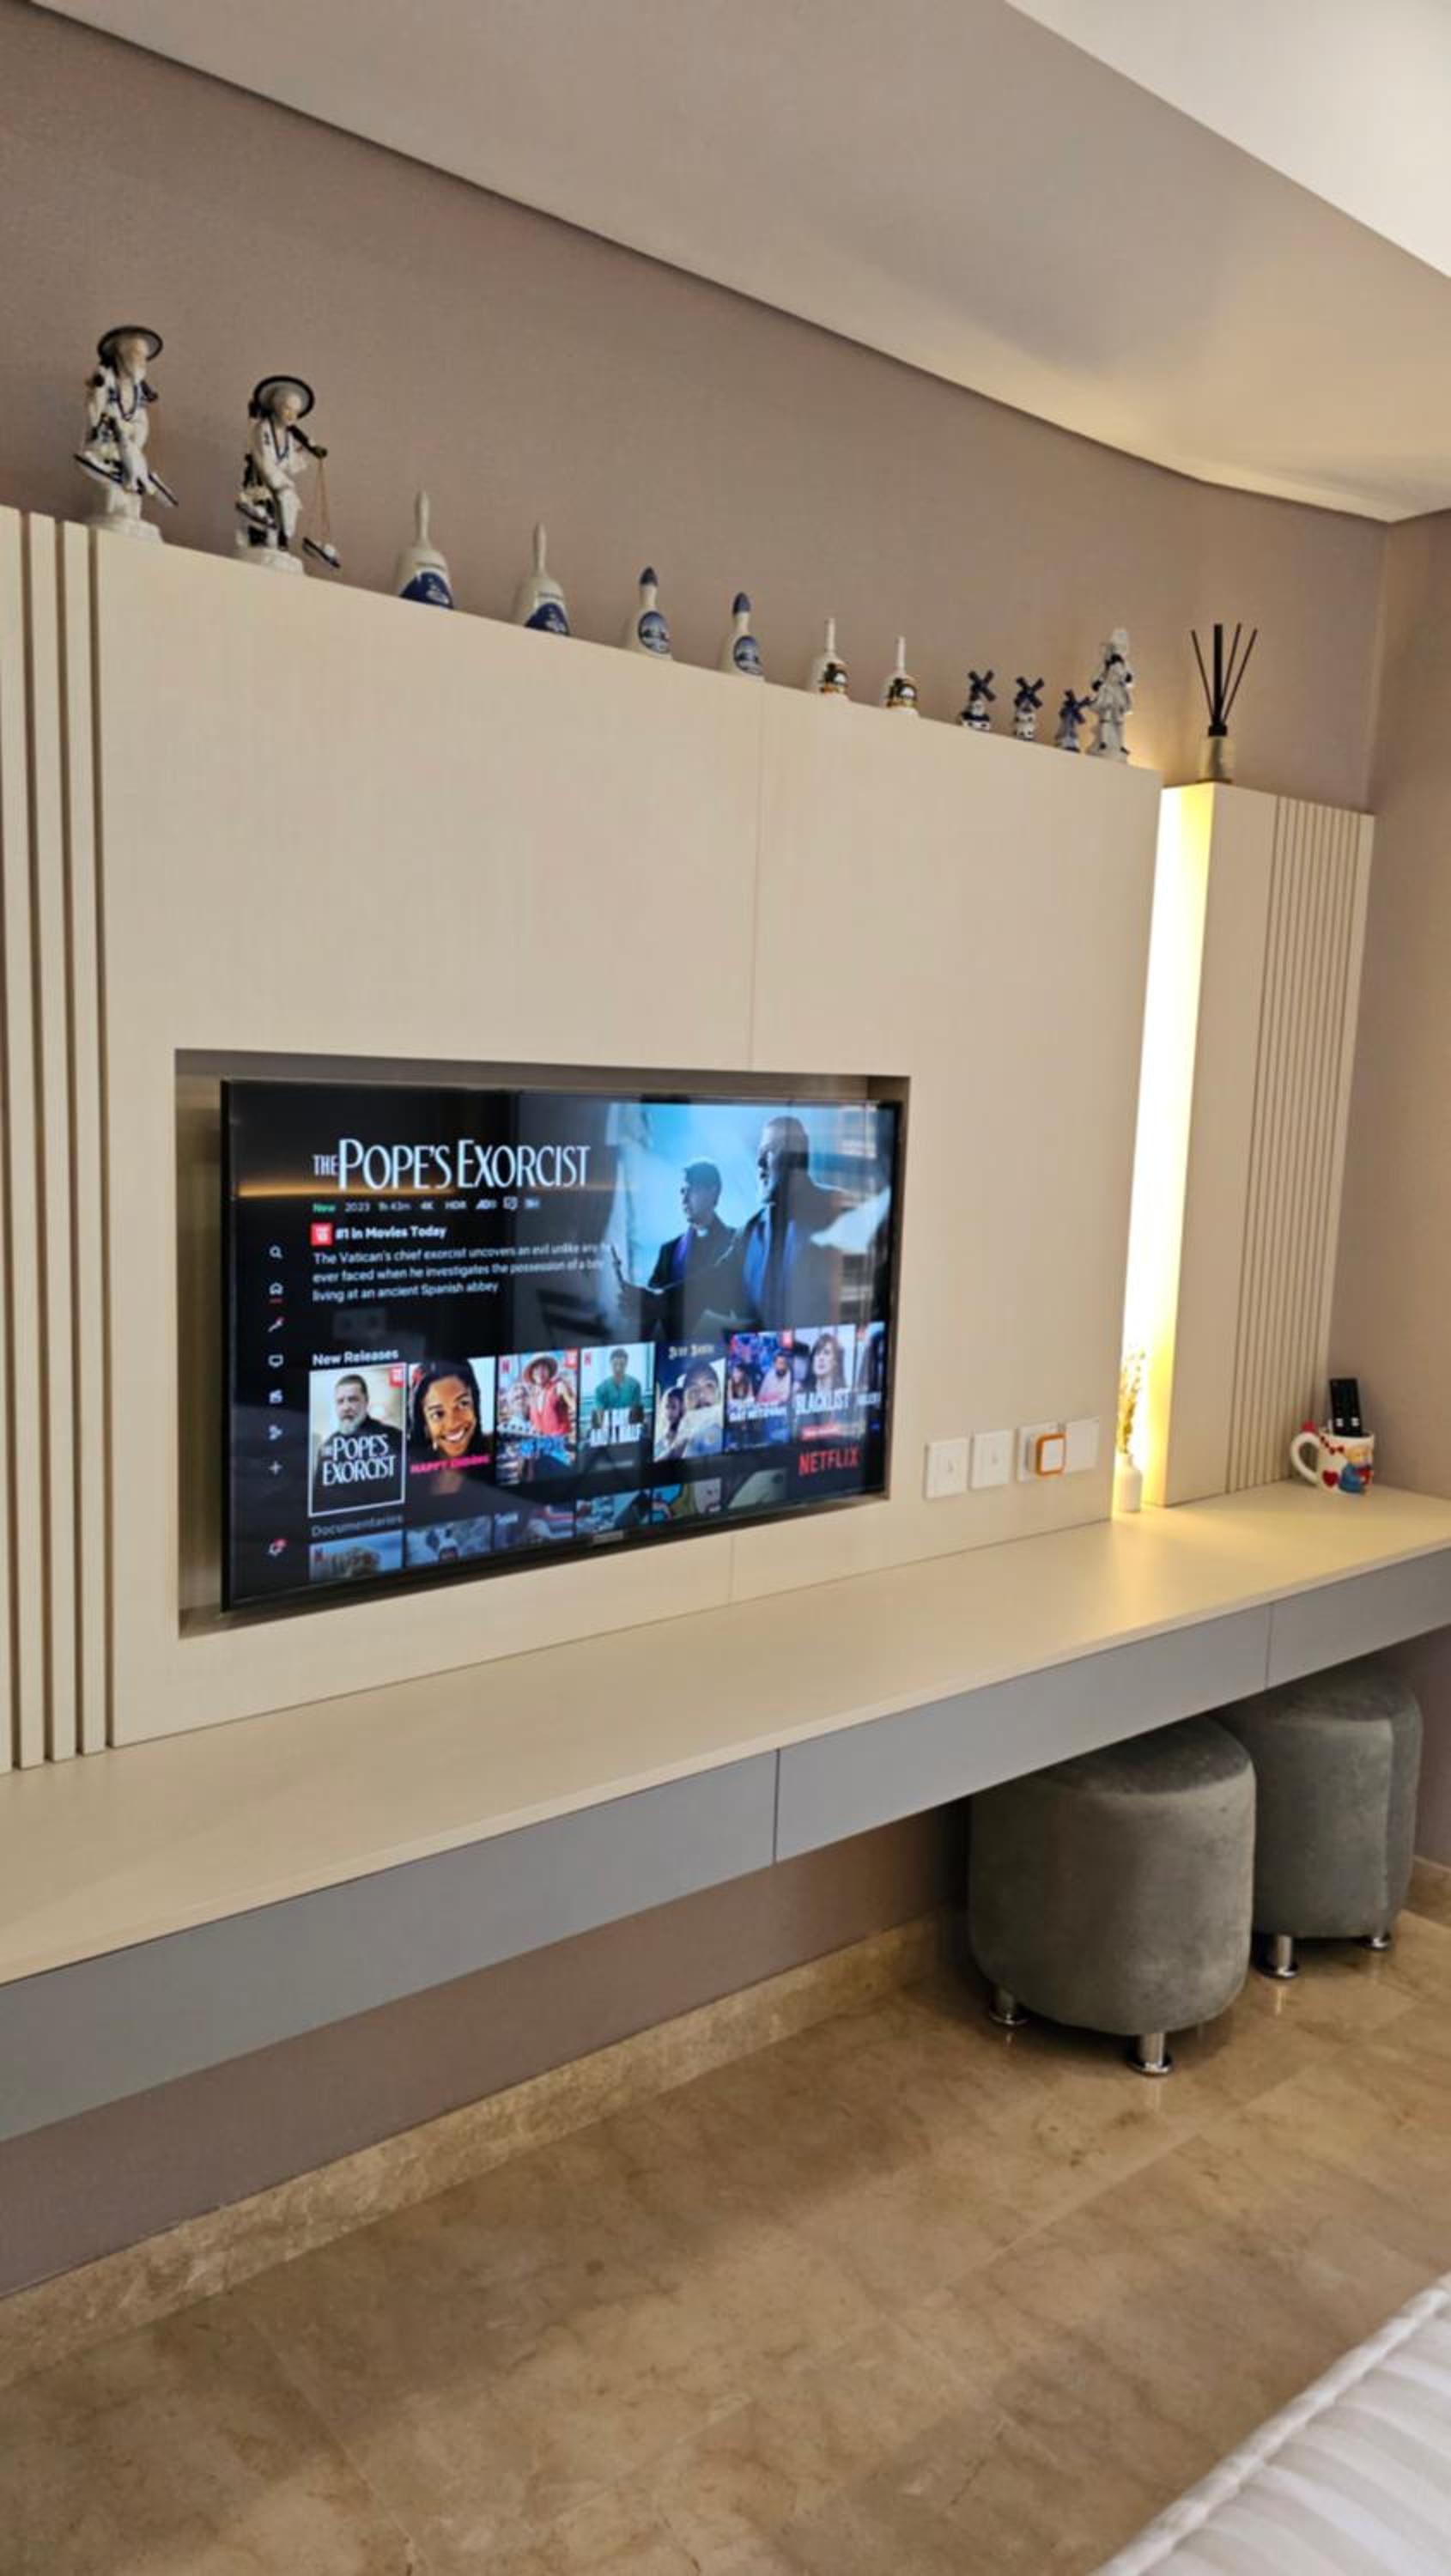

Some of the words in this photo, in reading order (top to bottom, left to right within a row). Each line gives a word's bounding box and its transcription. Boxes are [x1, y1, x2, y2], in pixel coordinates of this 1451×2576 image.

[313, 1154, 338, 1176] THE
[338, 1138, 452, 1191] POPE'S
[458, 1139, 591, 1188] EXORCIST
[366, 1225, 407, 1239] Movies
[410, 1224, 448, 1240] Today
[313, 1251, 337, 1265] The
[338, 1249, 392, 1265] Vatican's
[394, 1248, 422, 1261] chief
[424, 1248, 466, 1261] exorcist
[469, 1245, 515, 1259] uncovers
[532, 1243, 549, 1256] evil
[313, 1273, 339, 1285] ever
[343, 1268, 374, 1283] faced
[377, 1267, 408, 1281] when
[410, 1266, 423, 1279] he
[425, 1263, 489, 1279] investigates
[312, 1288, 344, 1304] living
[378, 1286, 419, 1301] ancient
[312, 1353, 342, 1367] New
[344, 1349, 399, 1364] Releases
[322, 1454, 397, 1486] EXORCIST
[798, 1445, 860, 1477] NETFLIX
